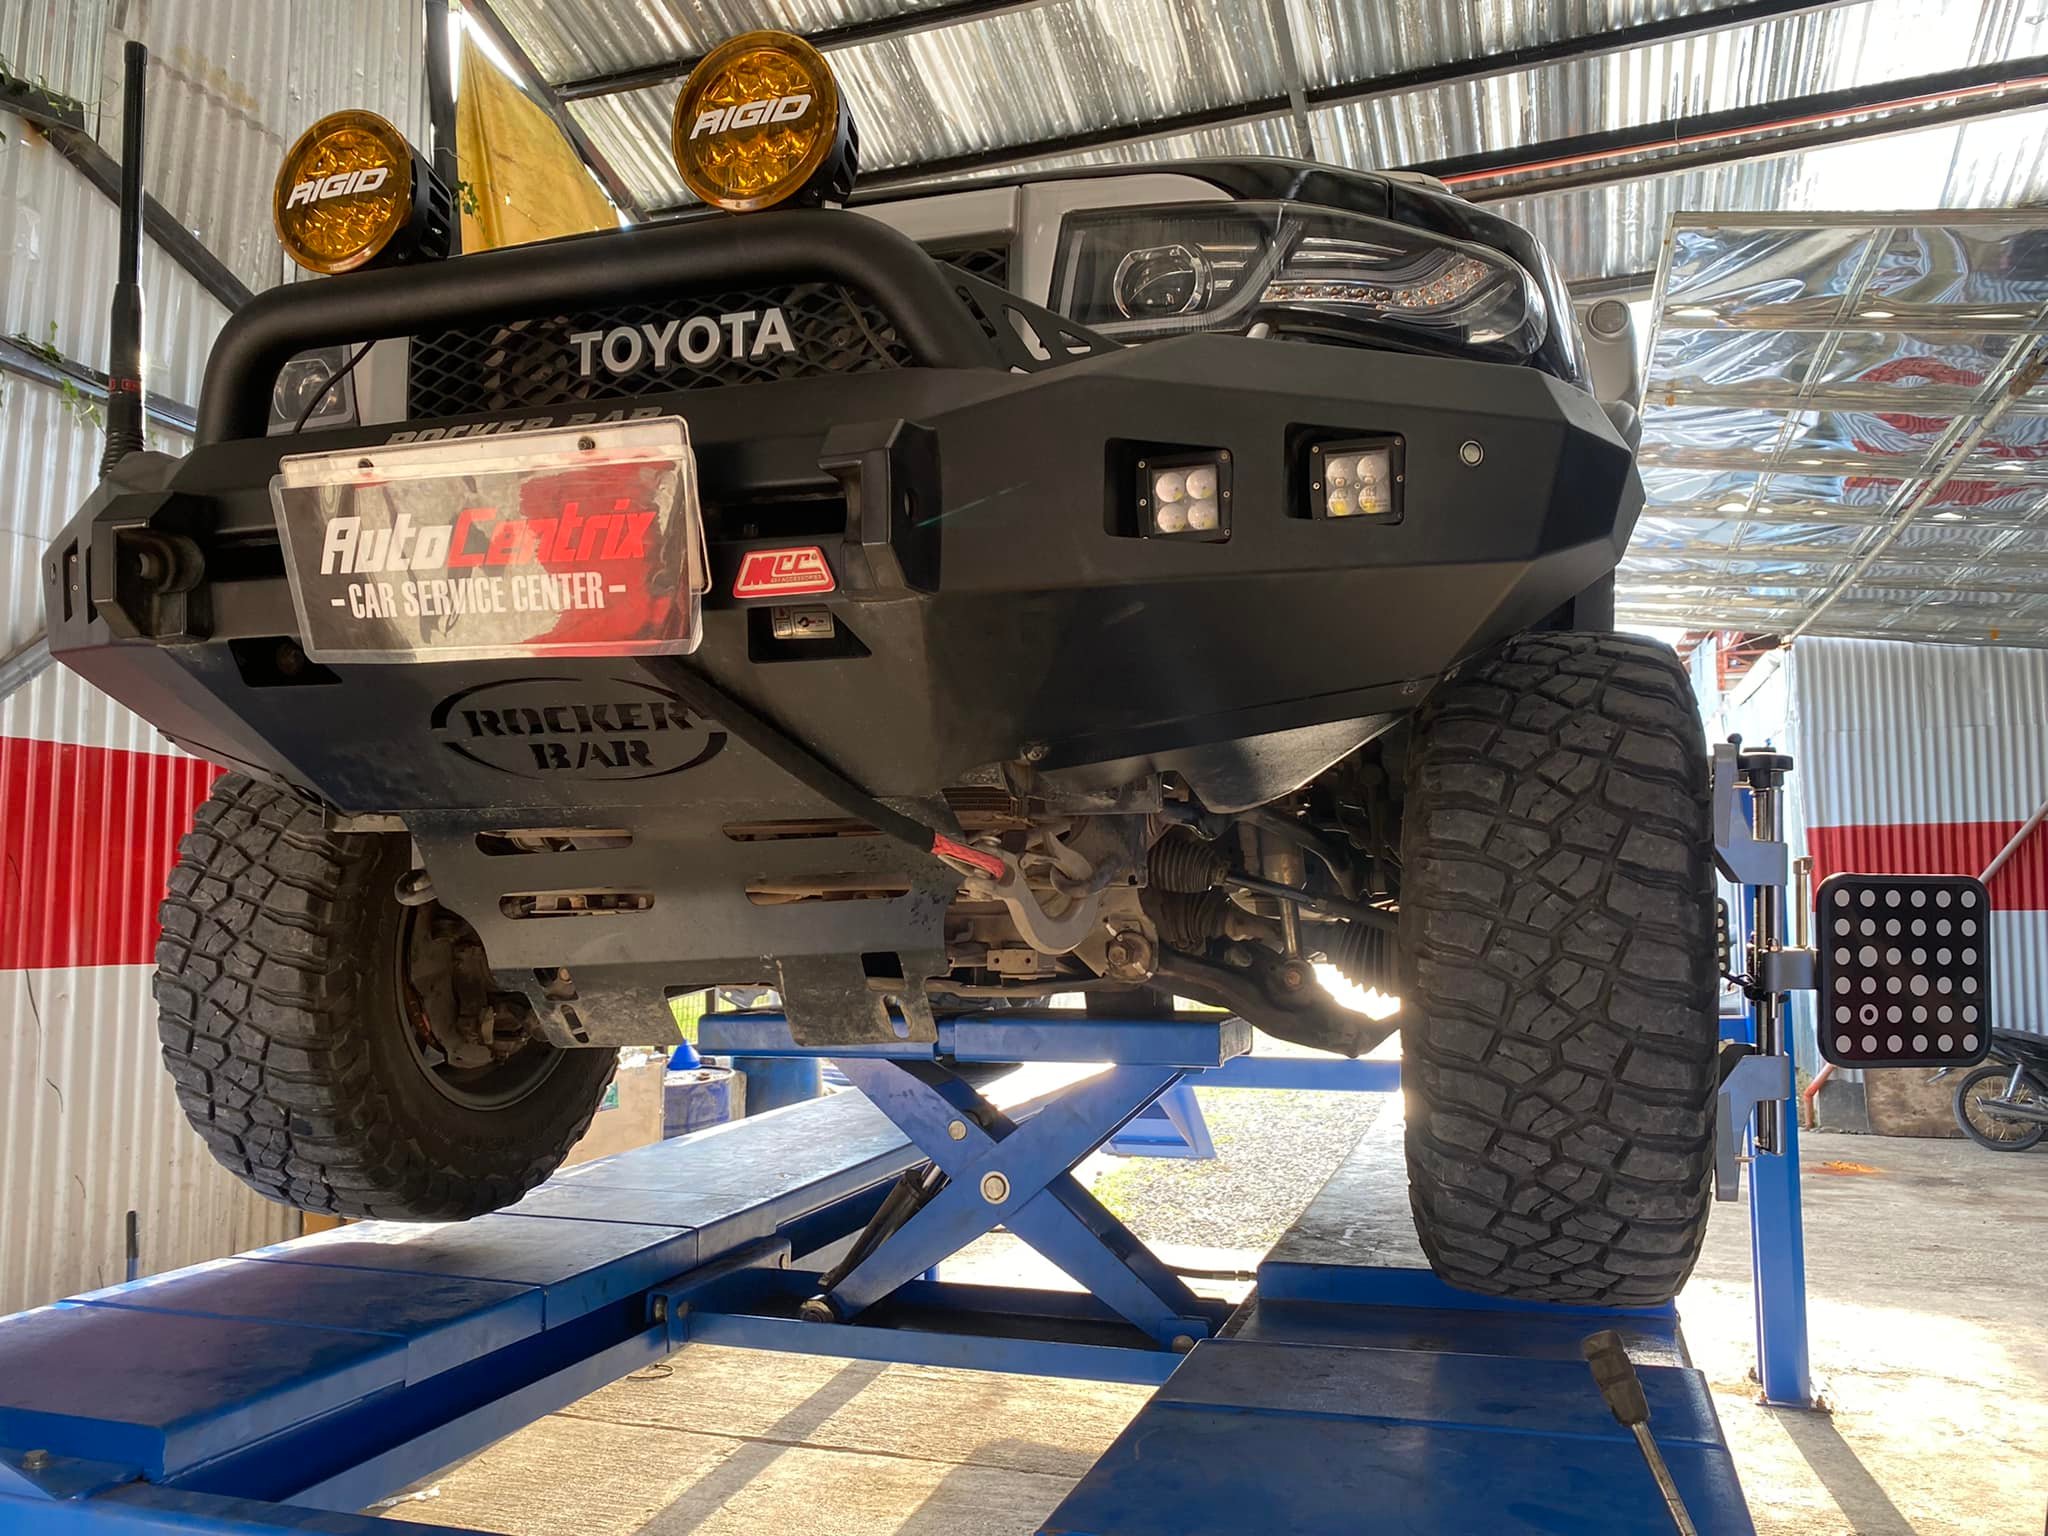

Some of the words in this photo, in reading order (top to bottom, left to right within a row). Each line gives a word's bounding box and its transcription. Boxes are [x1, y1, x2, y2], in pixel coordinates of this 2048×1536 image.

[690, 94, 811, 140] RIGID
[286, 167, 388, 210] RIGID
[570, 307, 796, 377] TOYOTA
[320, 499, 656, 575] AutoCentrix
[742, 553, 823, 586] MCC
[401, 576, 506, 616] SERVICE
[460, 702, 694, 737] ROCKER
[528, 740, 656, 770] BAR
